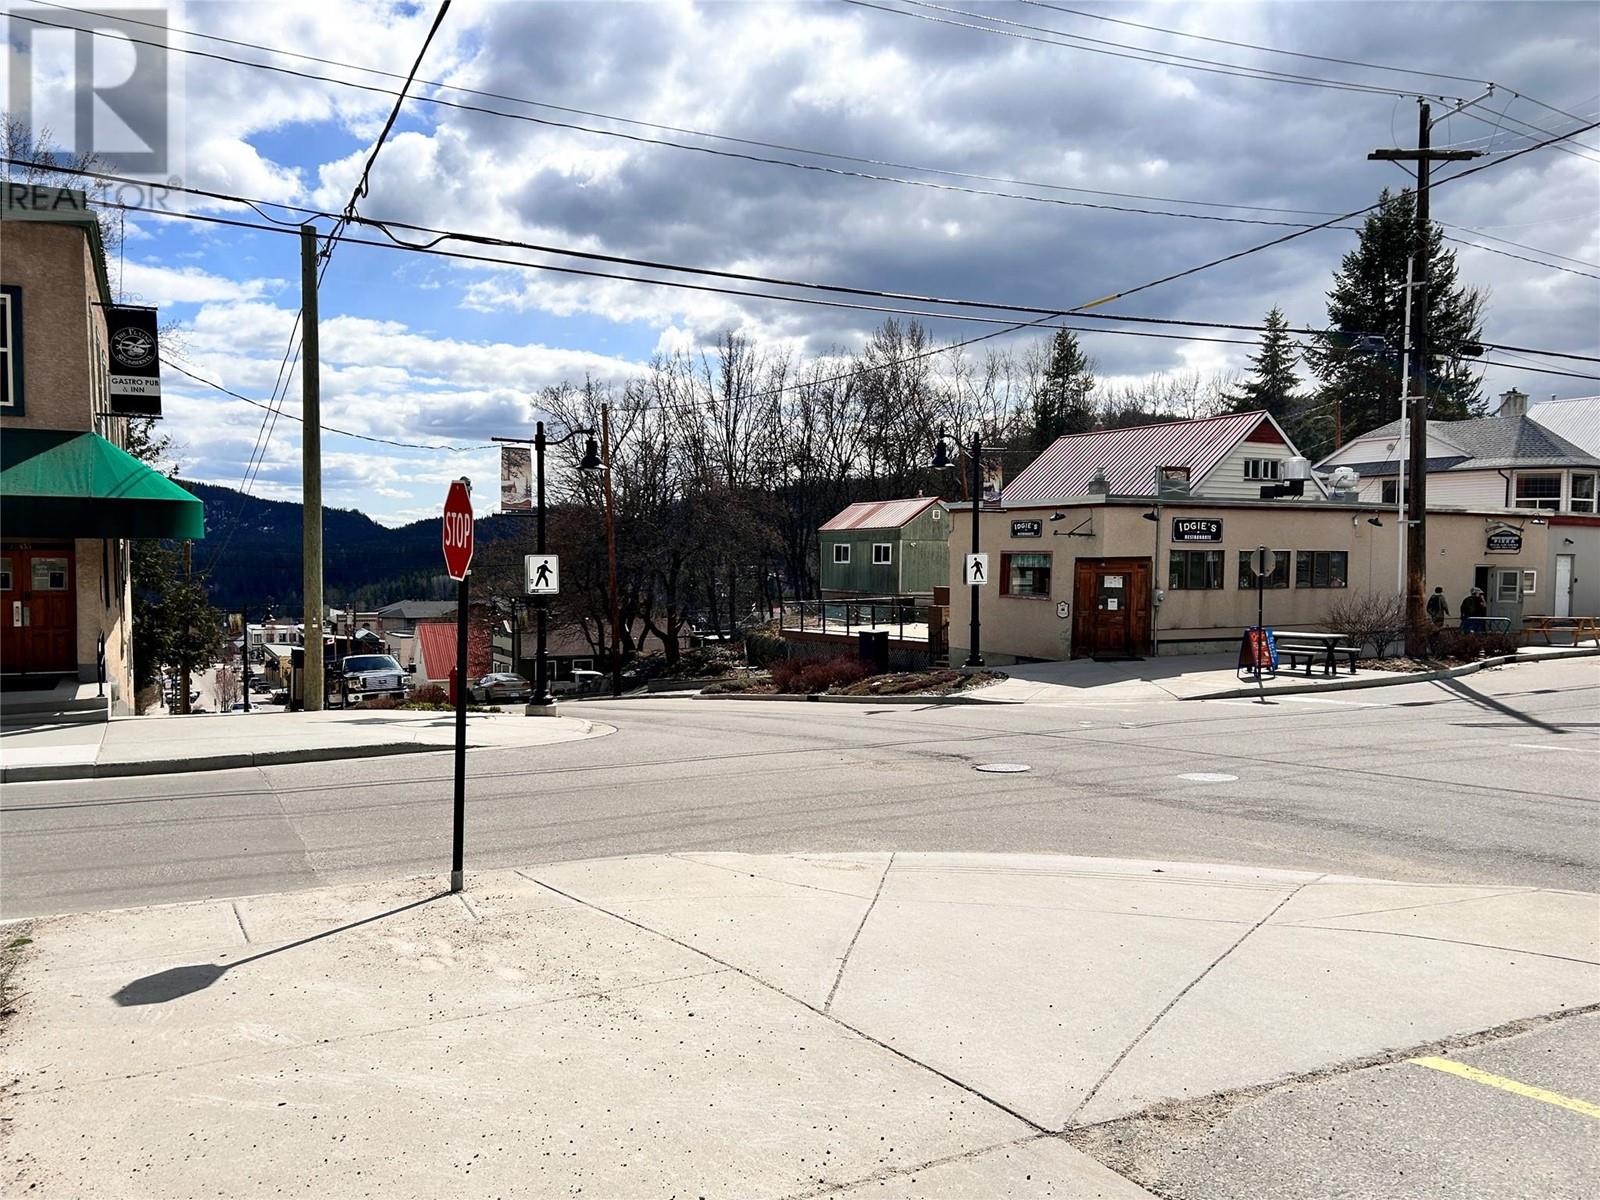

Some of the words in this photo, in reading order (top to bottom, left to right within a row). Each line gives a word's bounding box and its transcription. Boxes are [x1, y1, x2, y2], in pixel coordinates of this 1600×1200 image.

[111, 377, 143, 386] GASTRO
[145, 379, 159, 387] PUB
[445, 511, 471, 549] STOP
[1179, 521, 1218, 533] IDGIE'S
